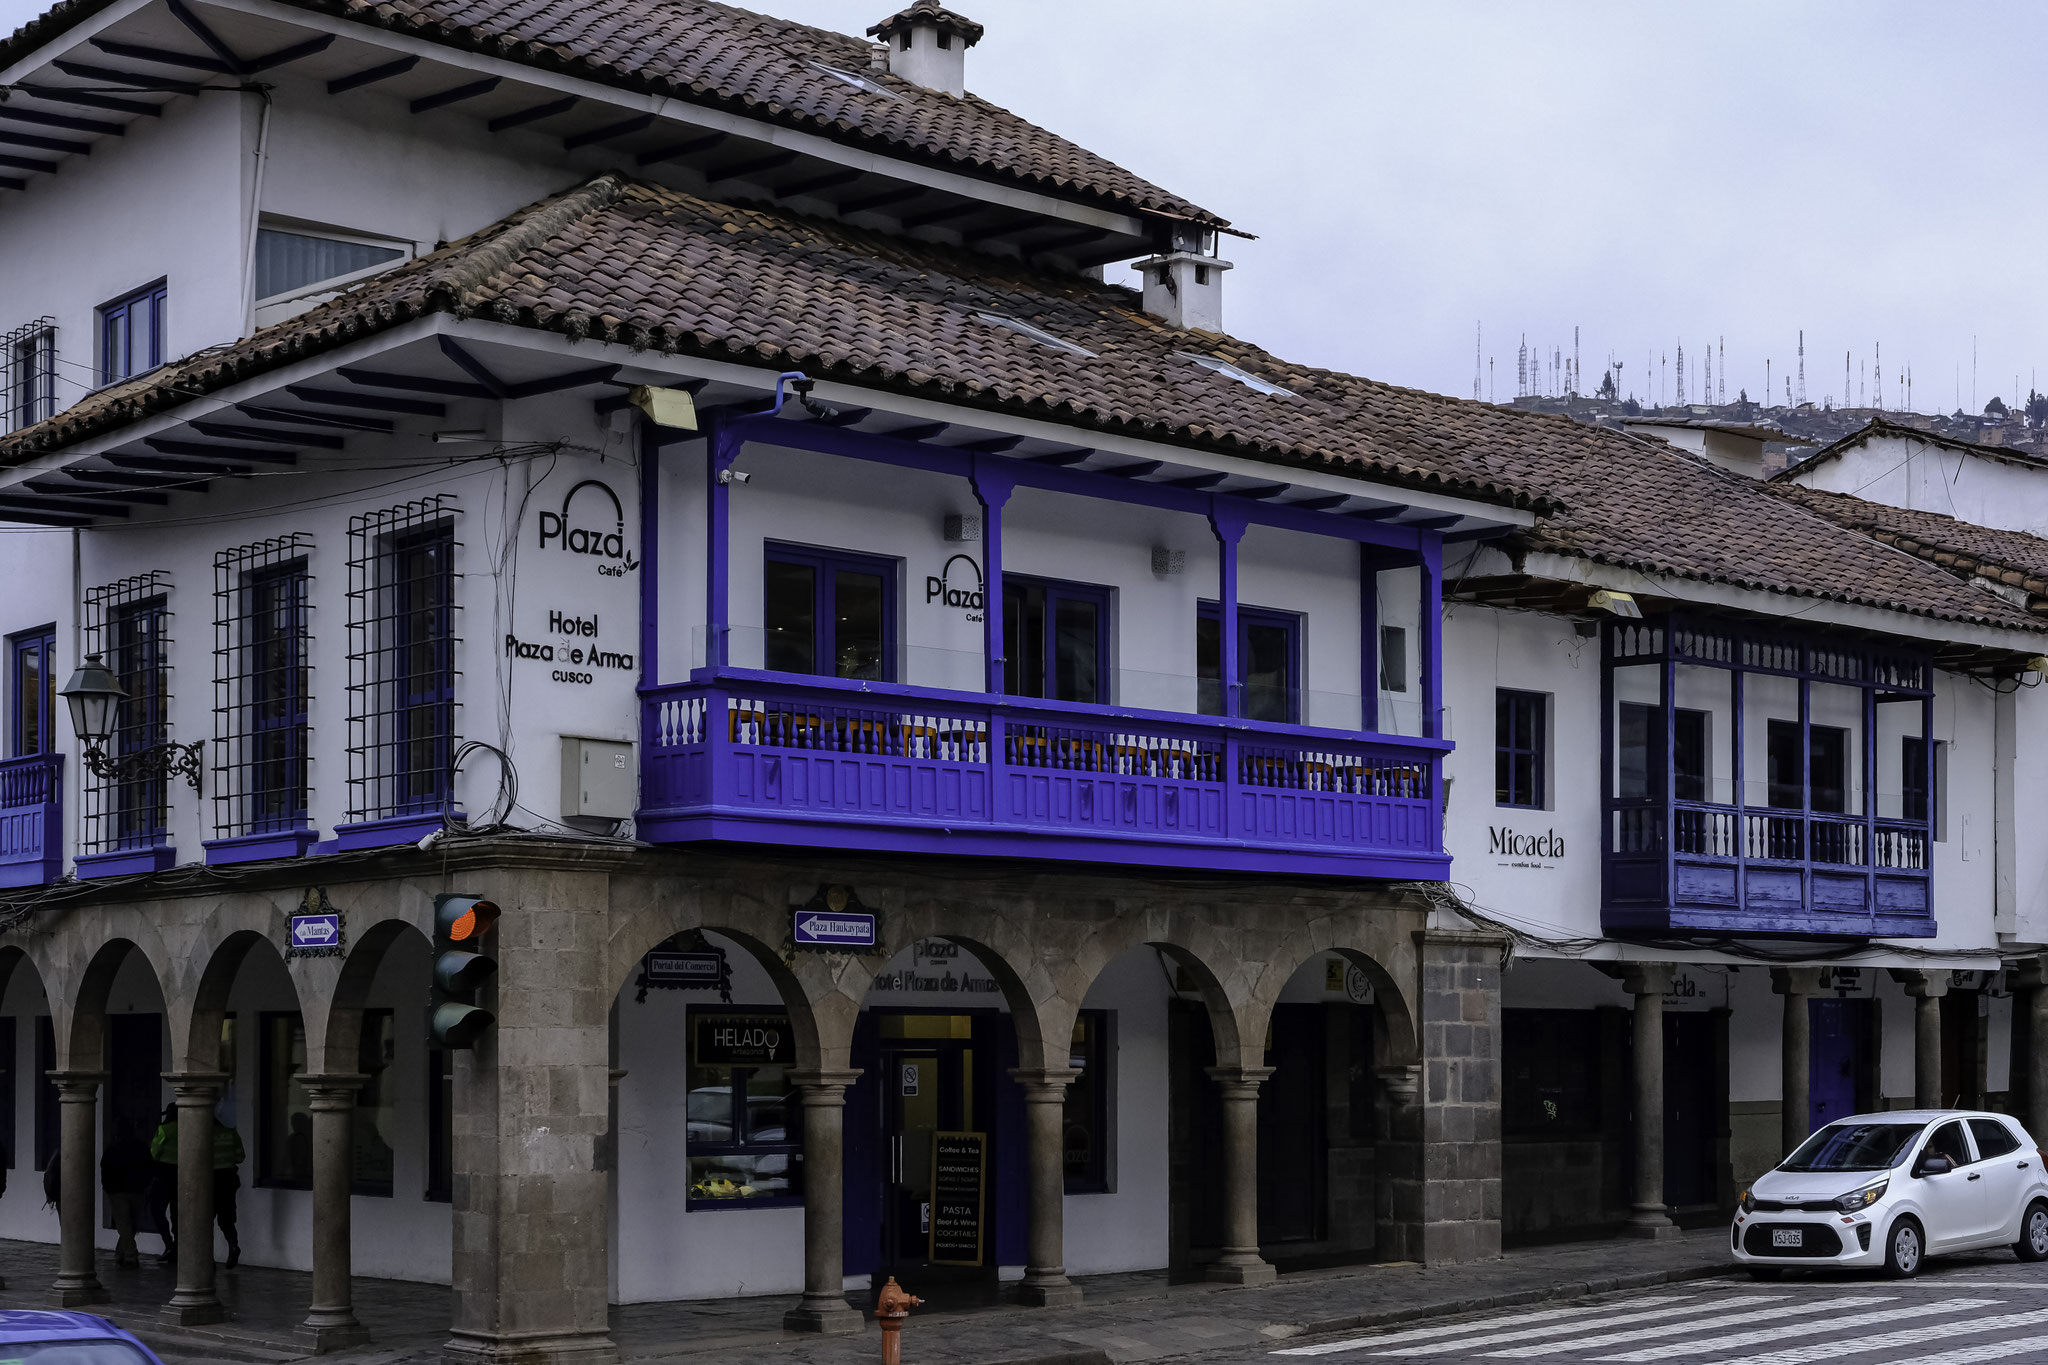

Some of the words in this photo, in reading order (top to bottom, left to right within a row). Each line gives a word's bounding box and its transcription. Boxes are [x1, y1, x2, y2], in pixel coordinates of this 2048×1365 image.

[540, 511, 623, 559] Plaza
[598, 565, 623, 577] Café
[927, 576, 984, 610] Plaza
[550, 610, 598, 638] Hotel
[966, 613, 983, 623] Café
[505, 634, 554, 661] Plaza
[1489, 826, 1564, 858] Micaela
[307, 925, 330, 936] Mantas
[810, 921, 828, 932] Plaza
[830, 922, 870, 936] Haukaypata
[653, 960, 673, 970] Portal
[674, 960, 683, 970] del
[685, 961, 715, 971] Comercio
[905, 970, 939, 991] Plaza
[940, 970, 958, 991] de
[714, 1028, 780, 1048] HELADO
[942, 1206, 972, 1215] PASTA
